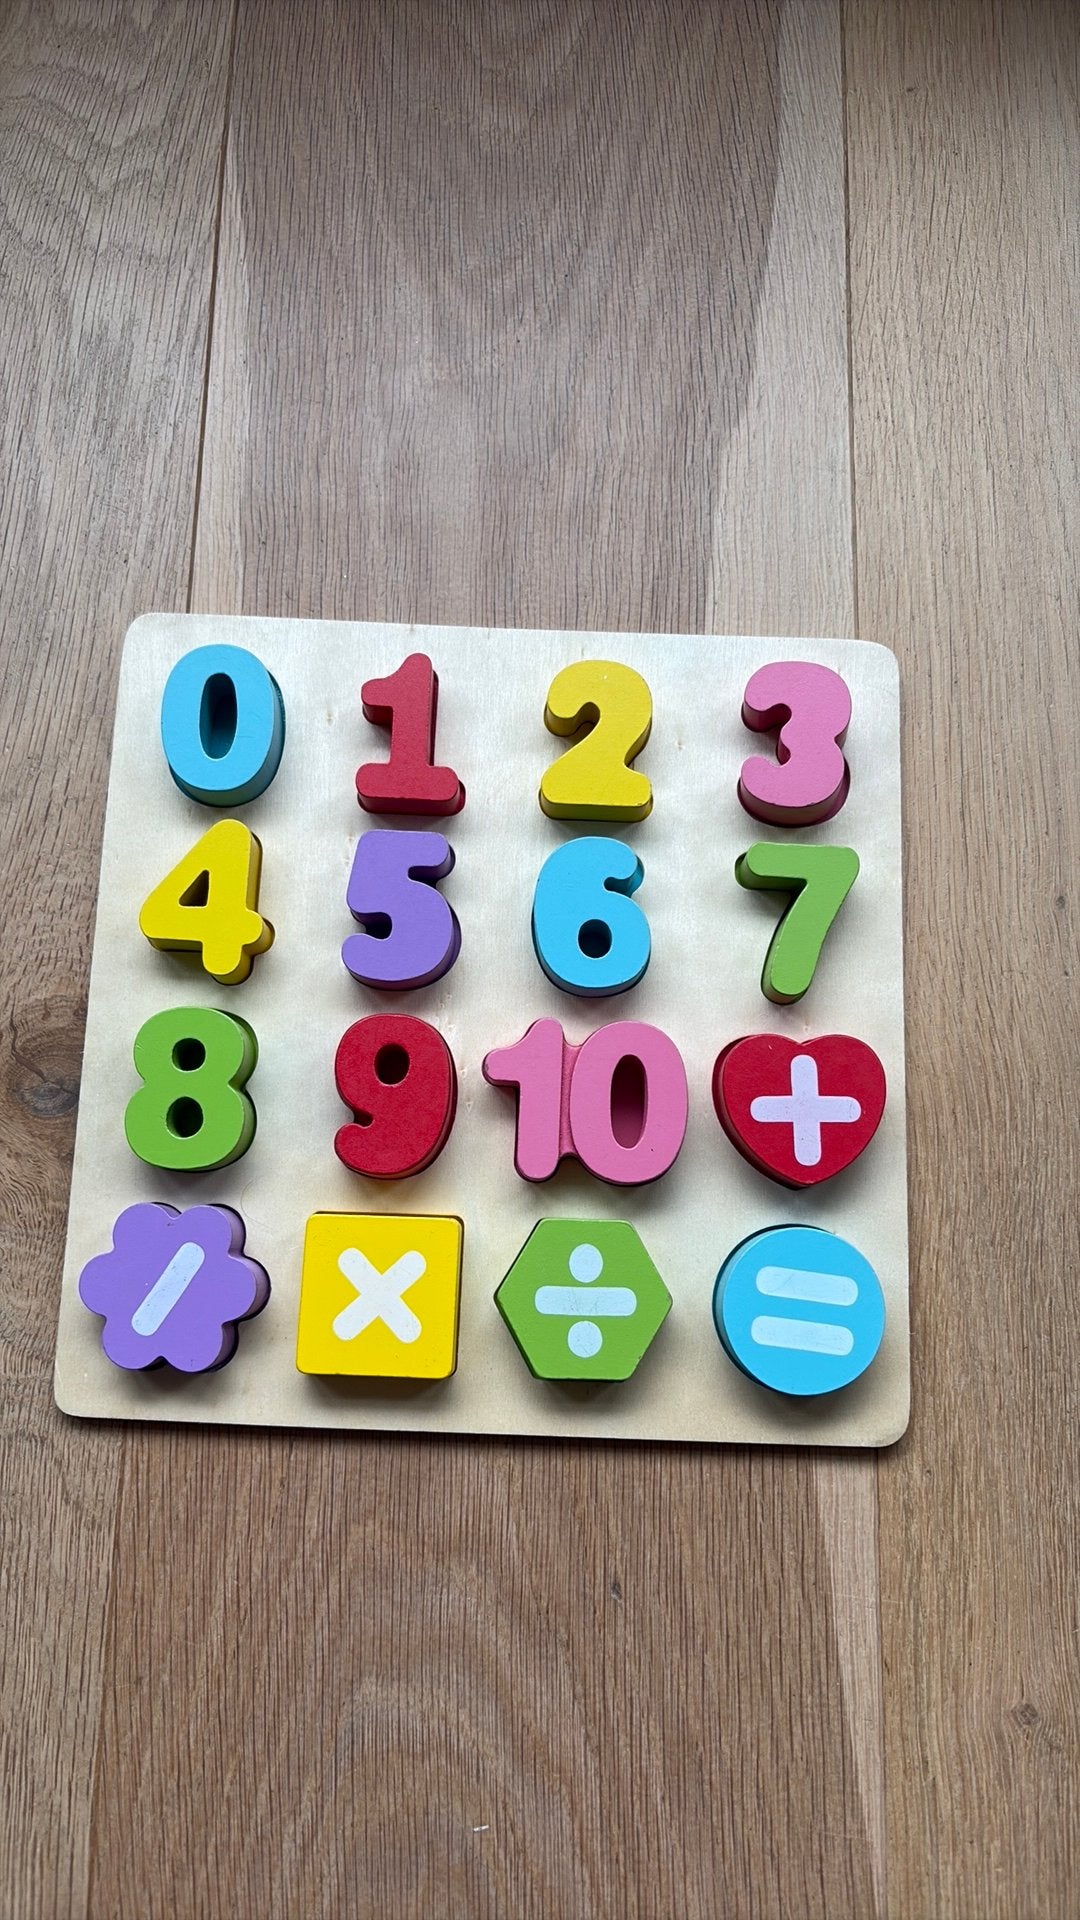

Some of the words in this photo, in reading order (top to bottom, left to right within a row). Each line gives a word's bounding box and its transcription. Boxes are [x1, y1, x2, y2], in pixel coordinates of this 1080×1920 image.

[161, 644, 285, 804] 0
[356, 653, 466, 816] 1
[539, 660, 653, 822] 2
[738, 661, 851, 825] 3
[139, 819, 275, 984] 4
[341, 830, 461, 990] 5
[531, 836, 651, 996] 6
[734, 842, 860, 1003] 7
[125, 1008, 257, 1171] 8
[334, 1013, 457, 1179] 9
[482, 1017, 689, 1185] 10
